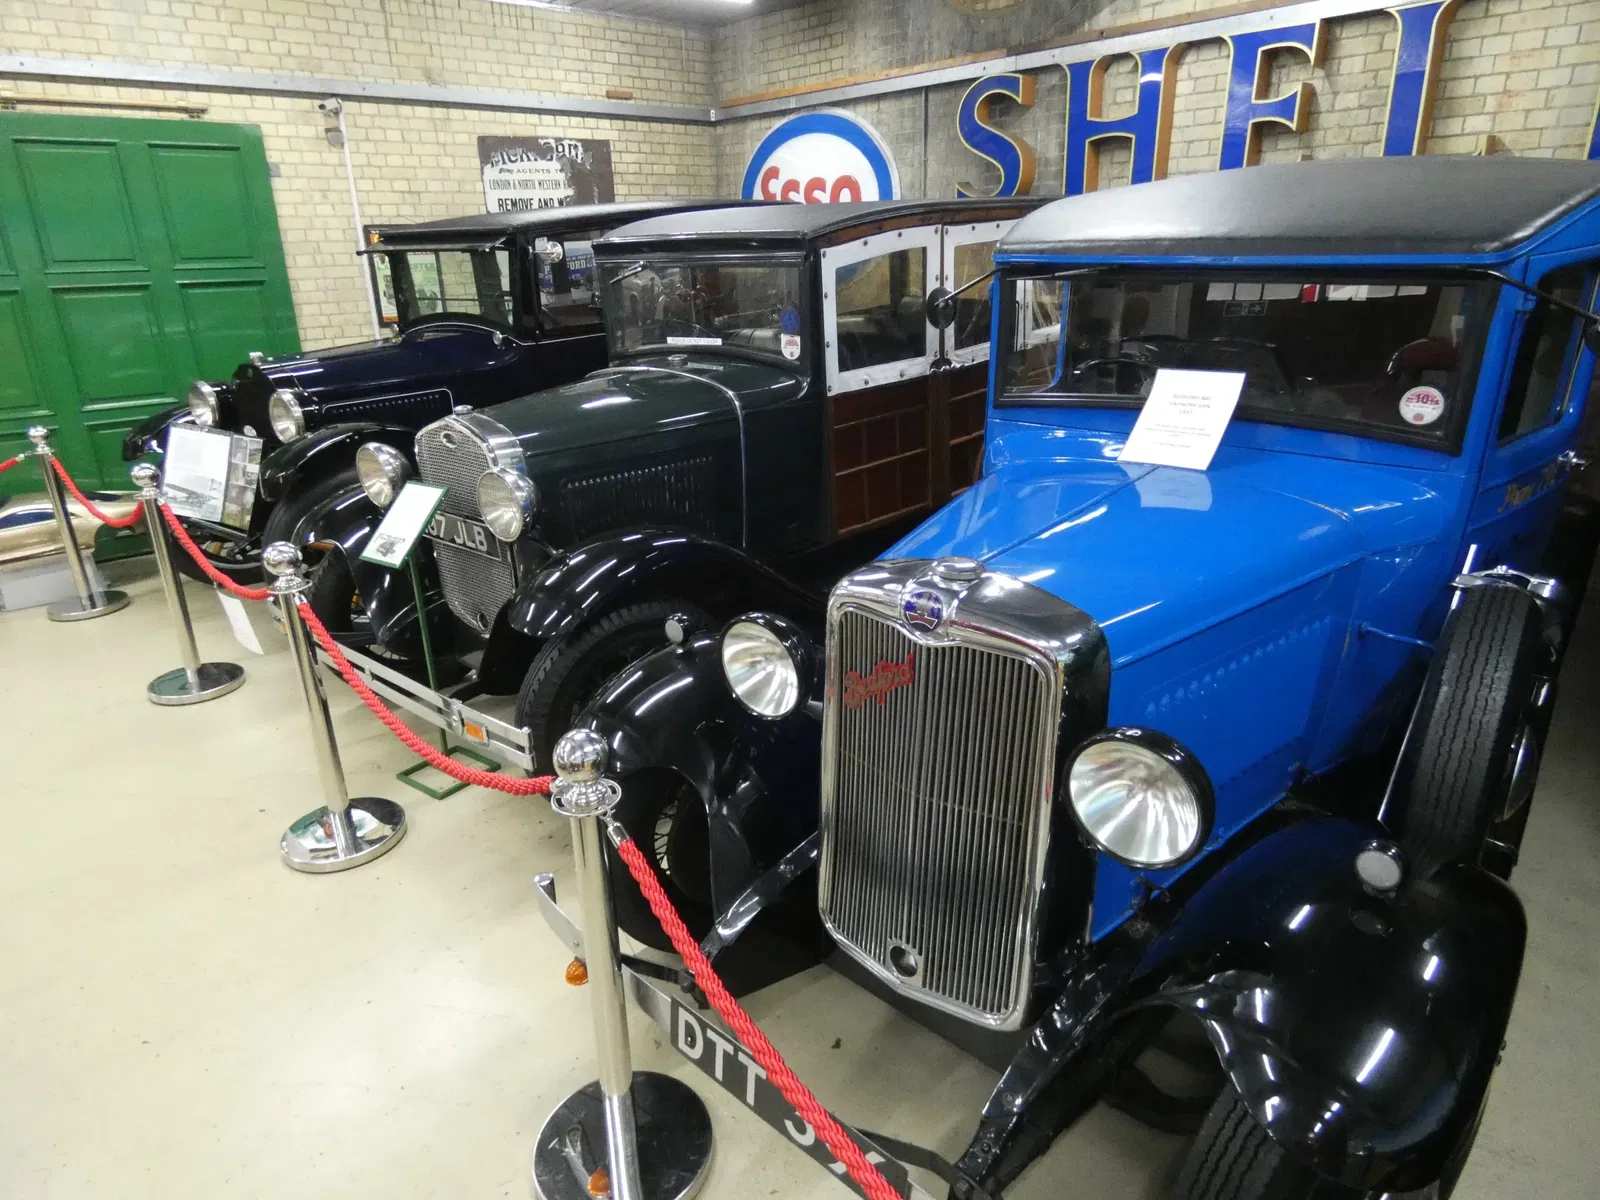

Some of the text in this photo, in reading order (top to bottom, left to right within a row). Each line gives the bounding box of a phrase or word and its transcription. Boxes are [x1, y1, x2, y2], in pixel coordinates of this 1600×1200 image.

[956, 0, 1600, 198] SHEL
[489, 179, 511, 190] LONDON
[512, 179, 517, 190] &
[517, 179, 536, 190] NORTH
[537, 179, 561, 190] WESTERN
[497, 197, 534, 212] REMOVE
[537, 197, 555, 209] AND
[453, 520, 488, 552] JLB
[844, 652, 915, 710] Bedford
[678, 1006, 767, 1107] DTT
